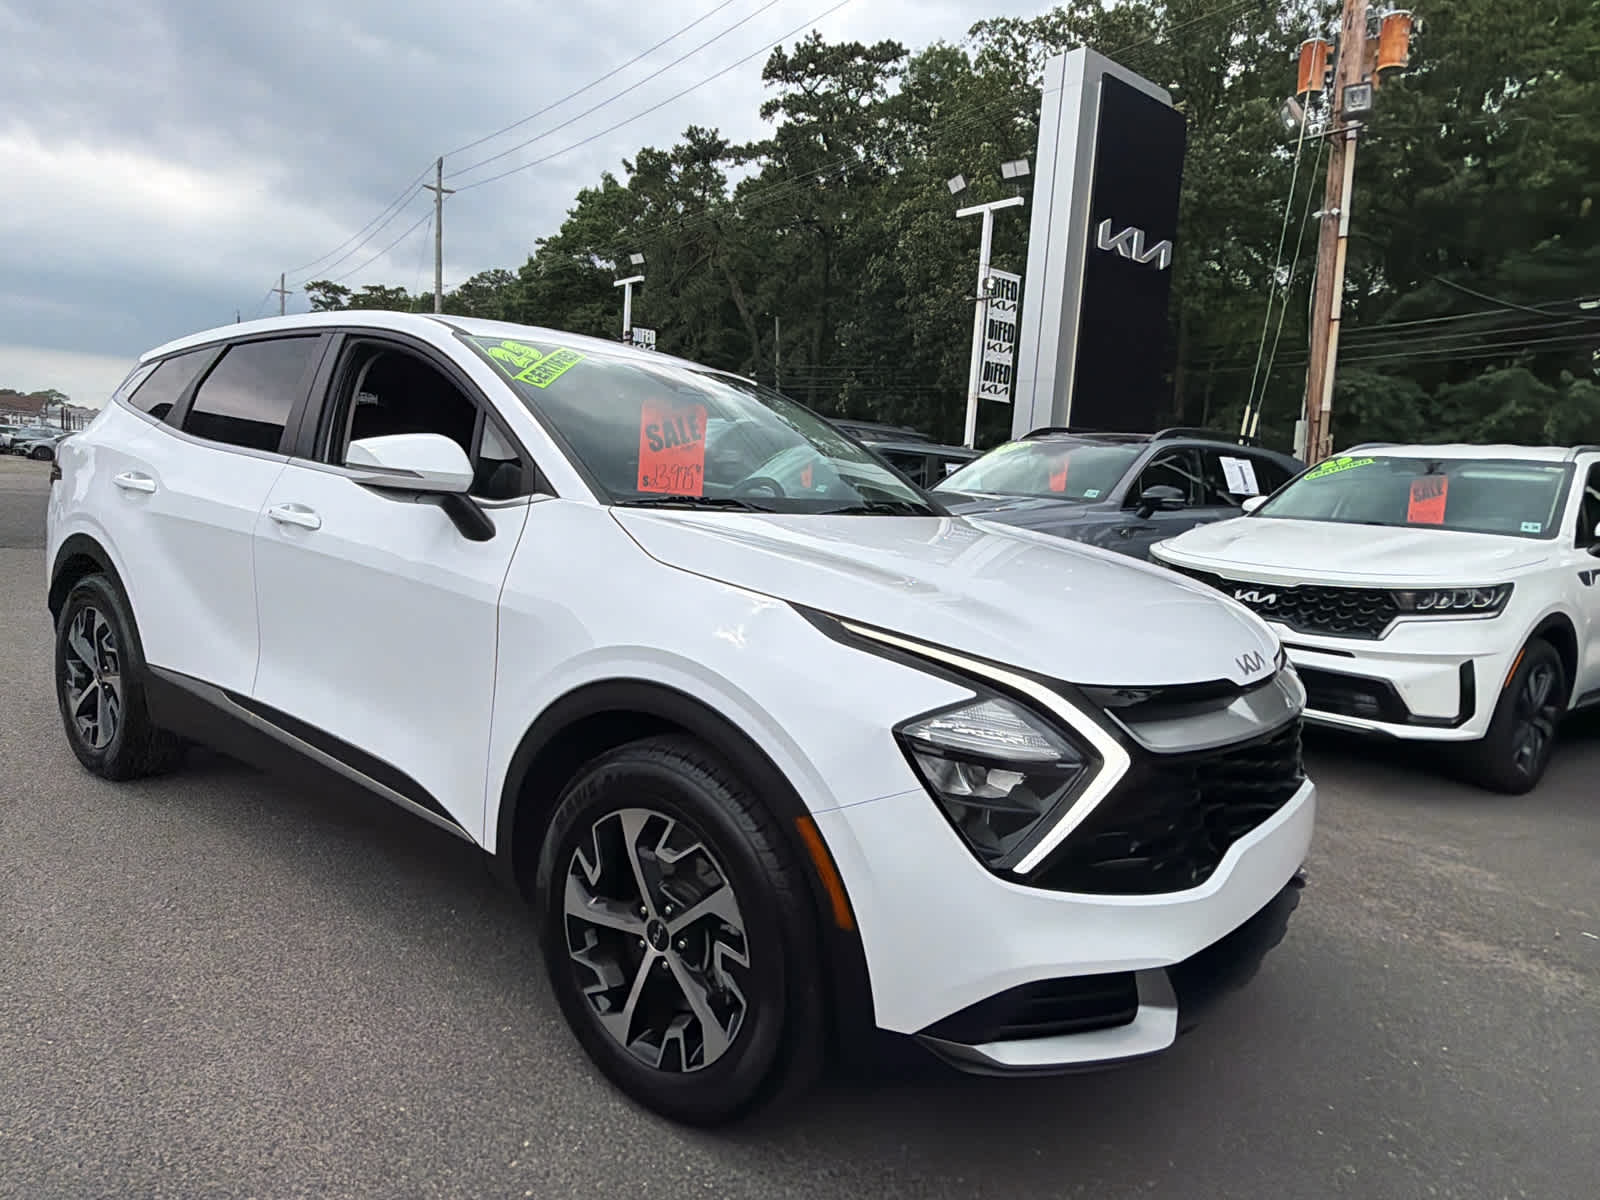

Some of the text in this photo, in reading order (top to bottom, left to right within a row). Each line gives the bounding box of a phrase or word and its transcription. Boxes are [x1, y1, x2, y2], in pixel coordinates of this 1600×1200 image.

[1098, 217, 1172, 270] KIA
[645, 413, 702, 453] SALE
[1235, 589, 1276, 604] KIA
